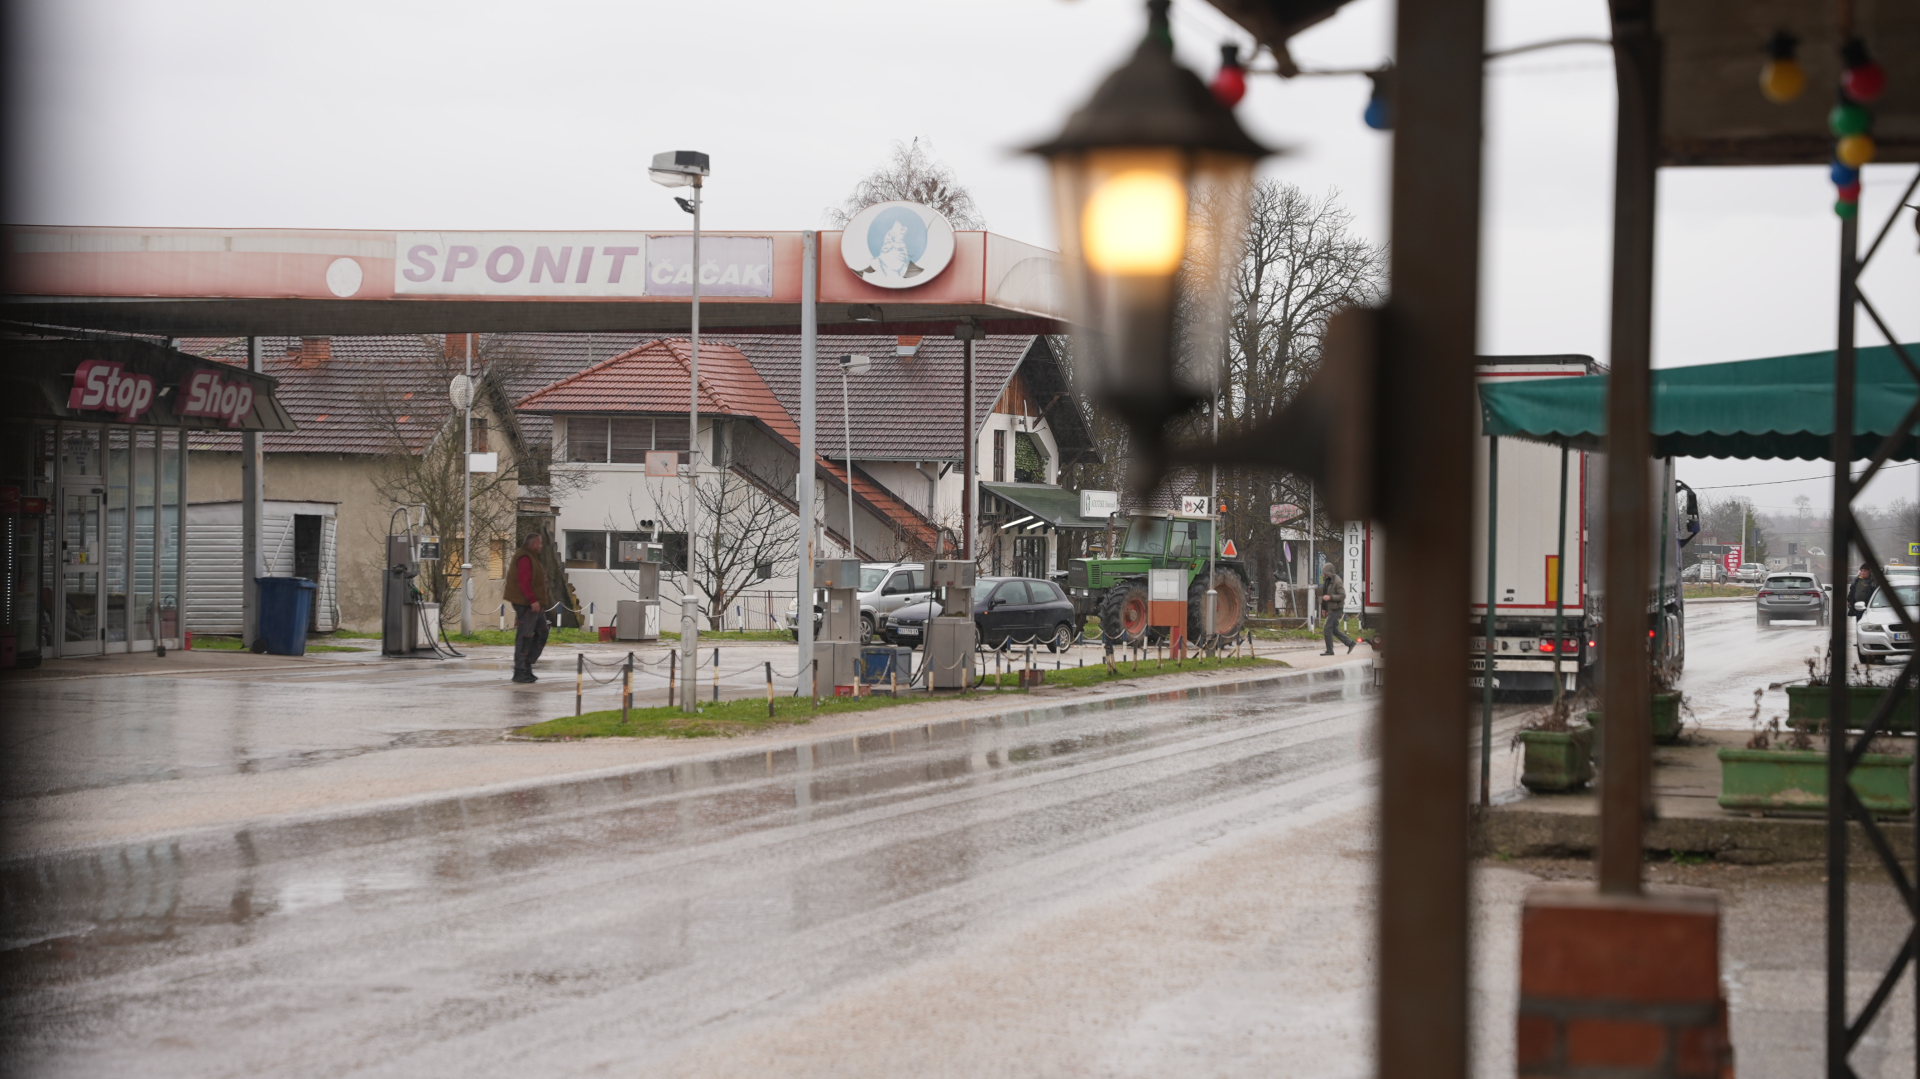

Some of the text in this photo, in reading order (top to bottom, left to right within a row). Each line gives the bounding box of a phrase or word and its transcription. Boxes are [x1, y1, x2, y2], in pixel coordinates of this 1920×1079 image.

[402, 244, 767, 286] SPONIT ČAČAK
[82, 365, 253, 423] Stop Shop
[1348, 522, 1359, 605] АПОТЕКА
[1469, 660, 1498, 669] MIZ
